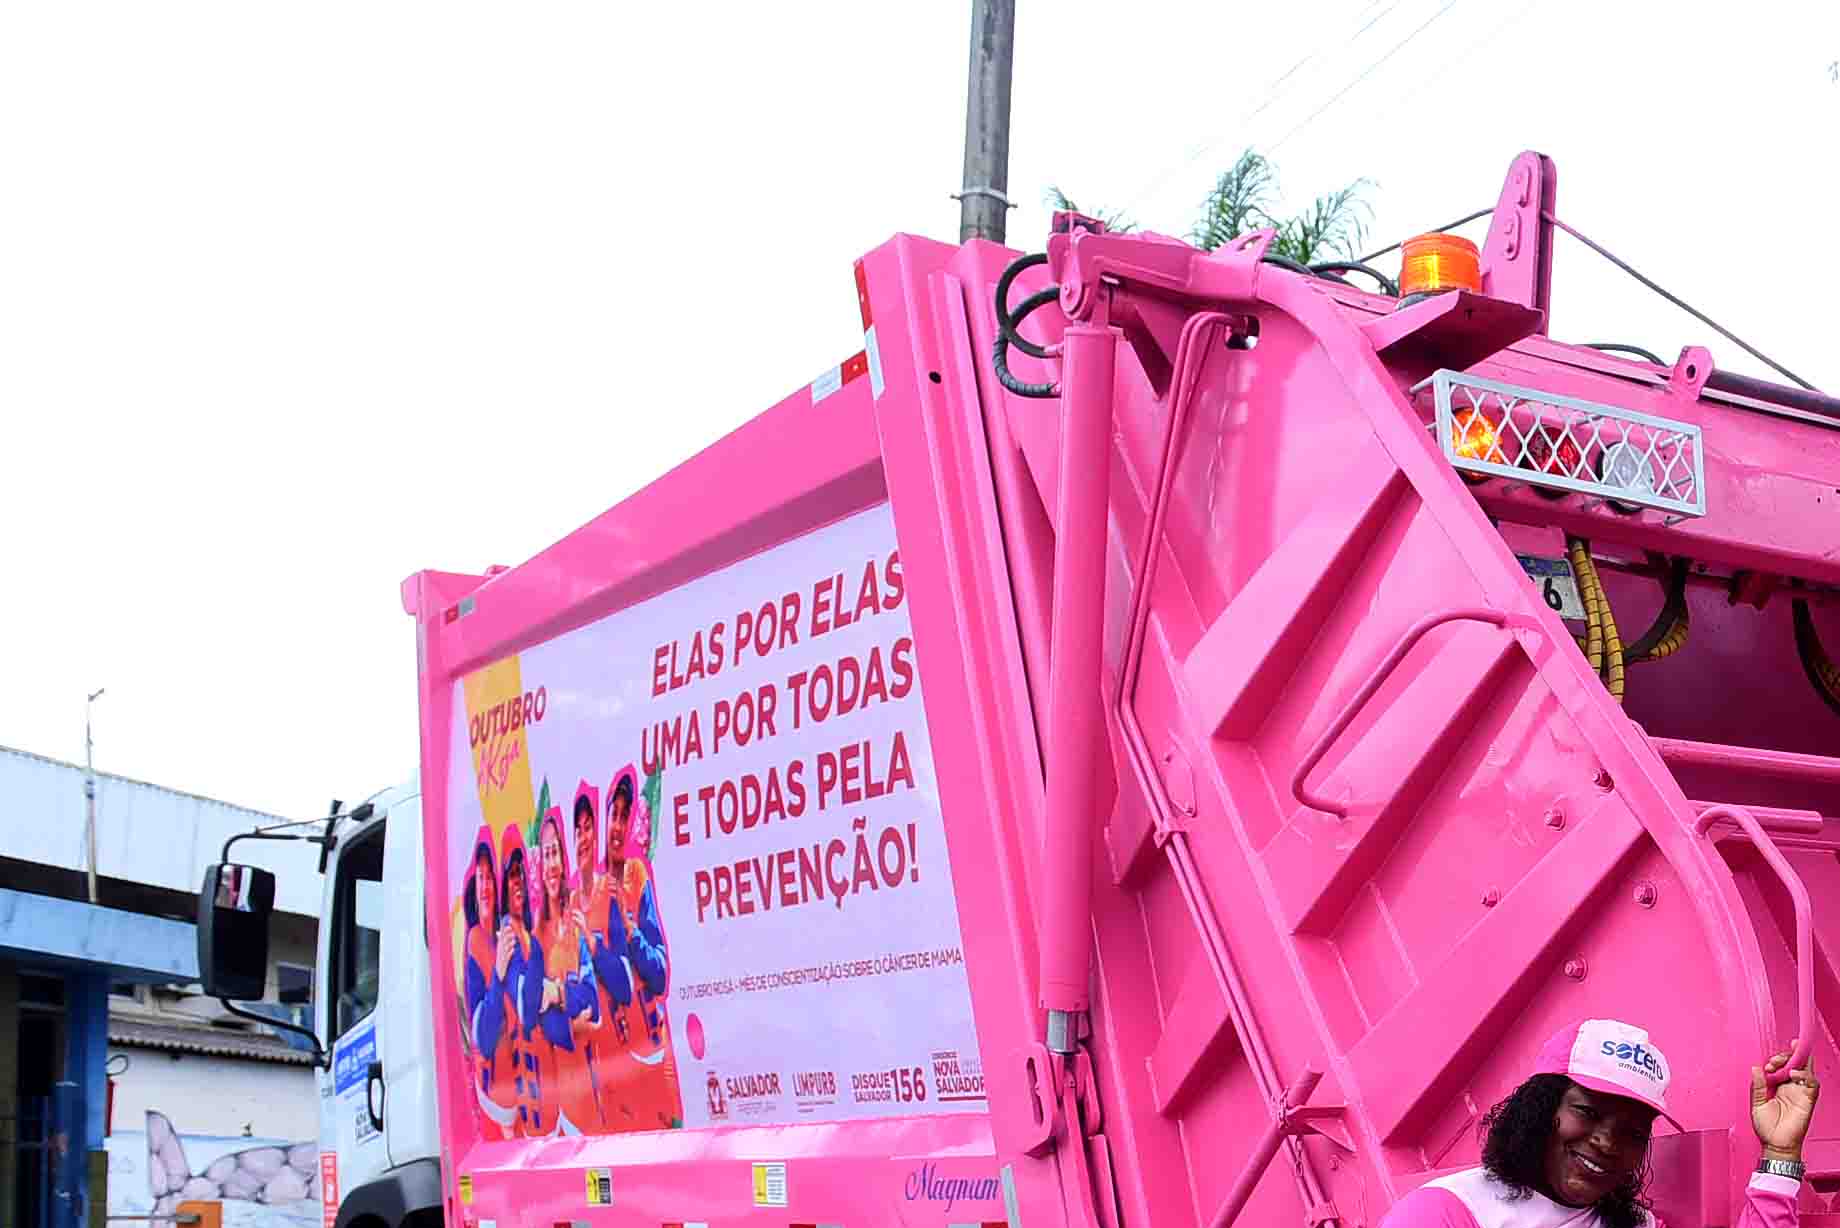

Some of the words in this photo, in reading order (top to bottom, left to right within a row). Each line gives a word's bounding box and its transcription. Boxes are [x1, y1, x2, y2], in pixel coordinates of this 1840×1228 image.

[652, 621, 725, 697] ELAS
[734, 591, 801, 667] POR
[810, 551, 905, 637] ELAS
[470, 685, 546, 750] OUTUBRO
[641, 709, 704, 777] UMA
[713, 683, 777, 754] POR
[787, 637, 913, 729] TODAS
[673, 793, 691, 847] E
[698, 760, 806, 839] TODAS
[817, 731, 915, 811] PELA
[695, 816, 919, 923] PREVENÇÃO!
[842, 960, 873, 979] SOBRE
[882, 953, 918, 974] CÂNCER
[931, 947, 963, 968] MAMA
[726, 1072, 782, 1099] SALVADOR
[851, 1071, 891, 1090] DISQUE
[890, 1066, 926, 1103] 156
[933, 1060, 960, 1077] NOVA
[905, 1161, 999, 1213] Magnum
